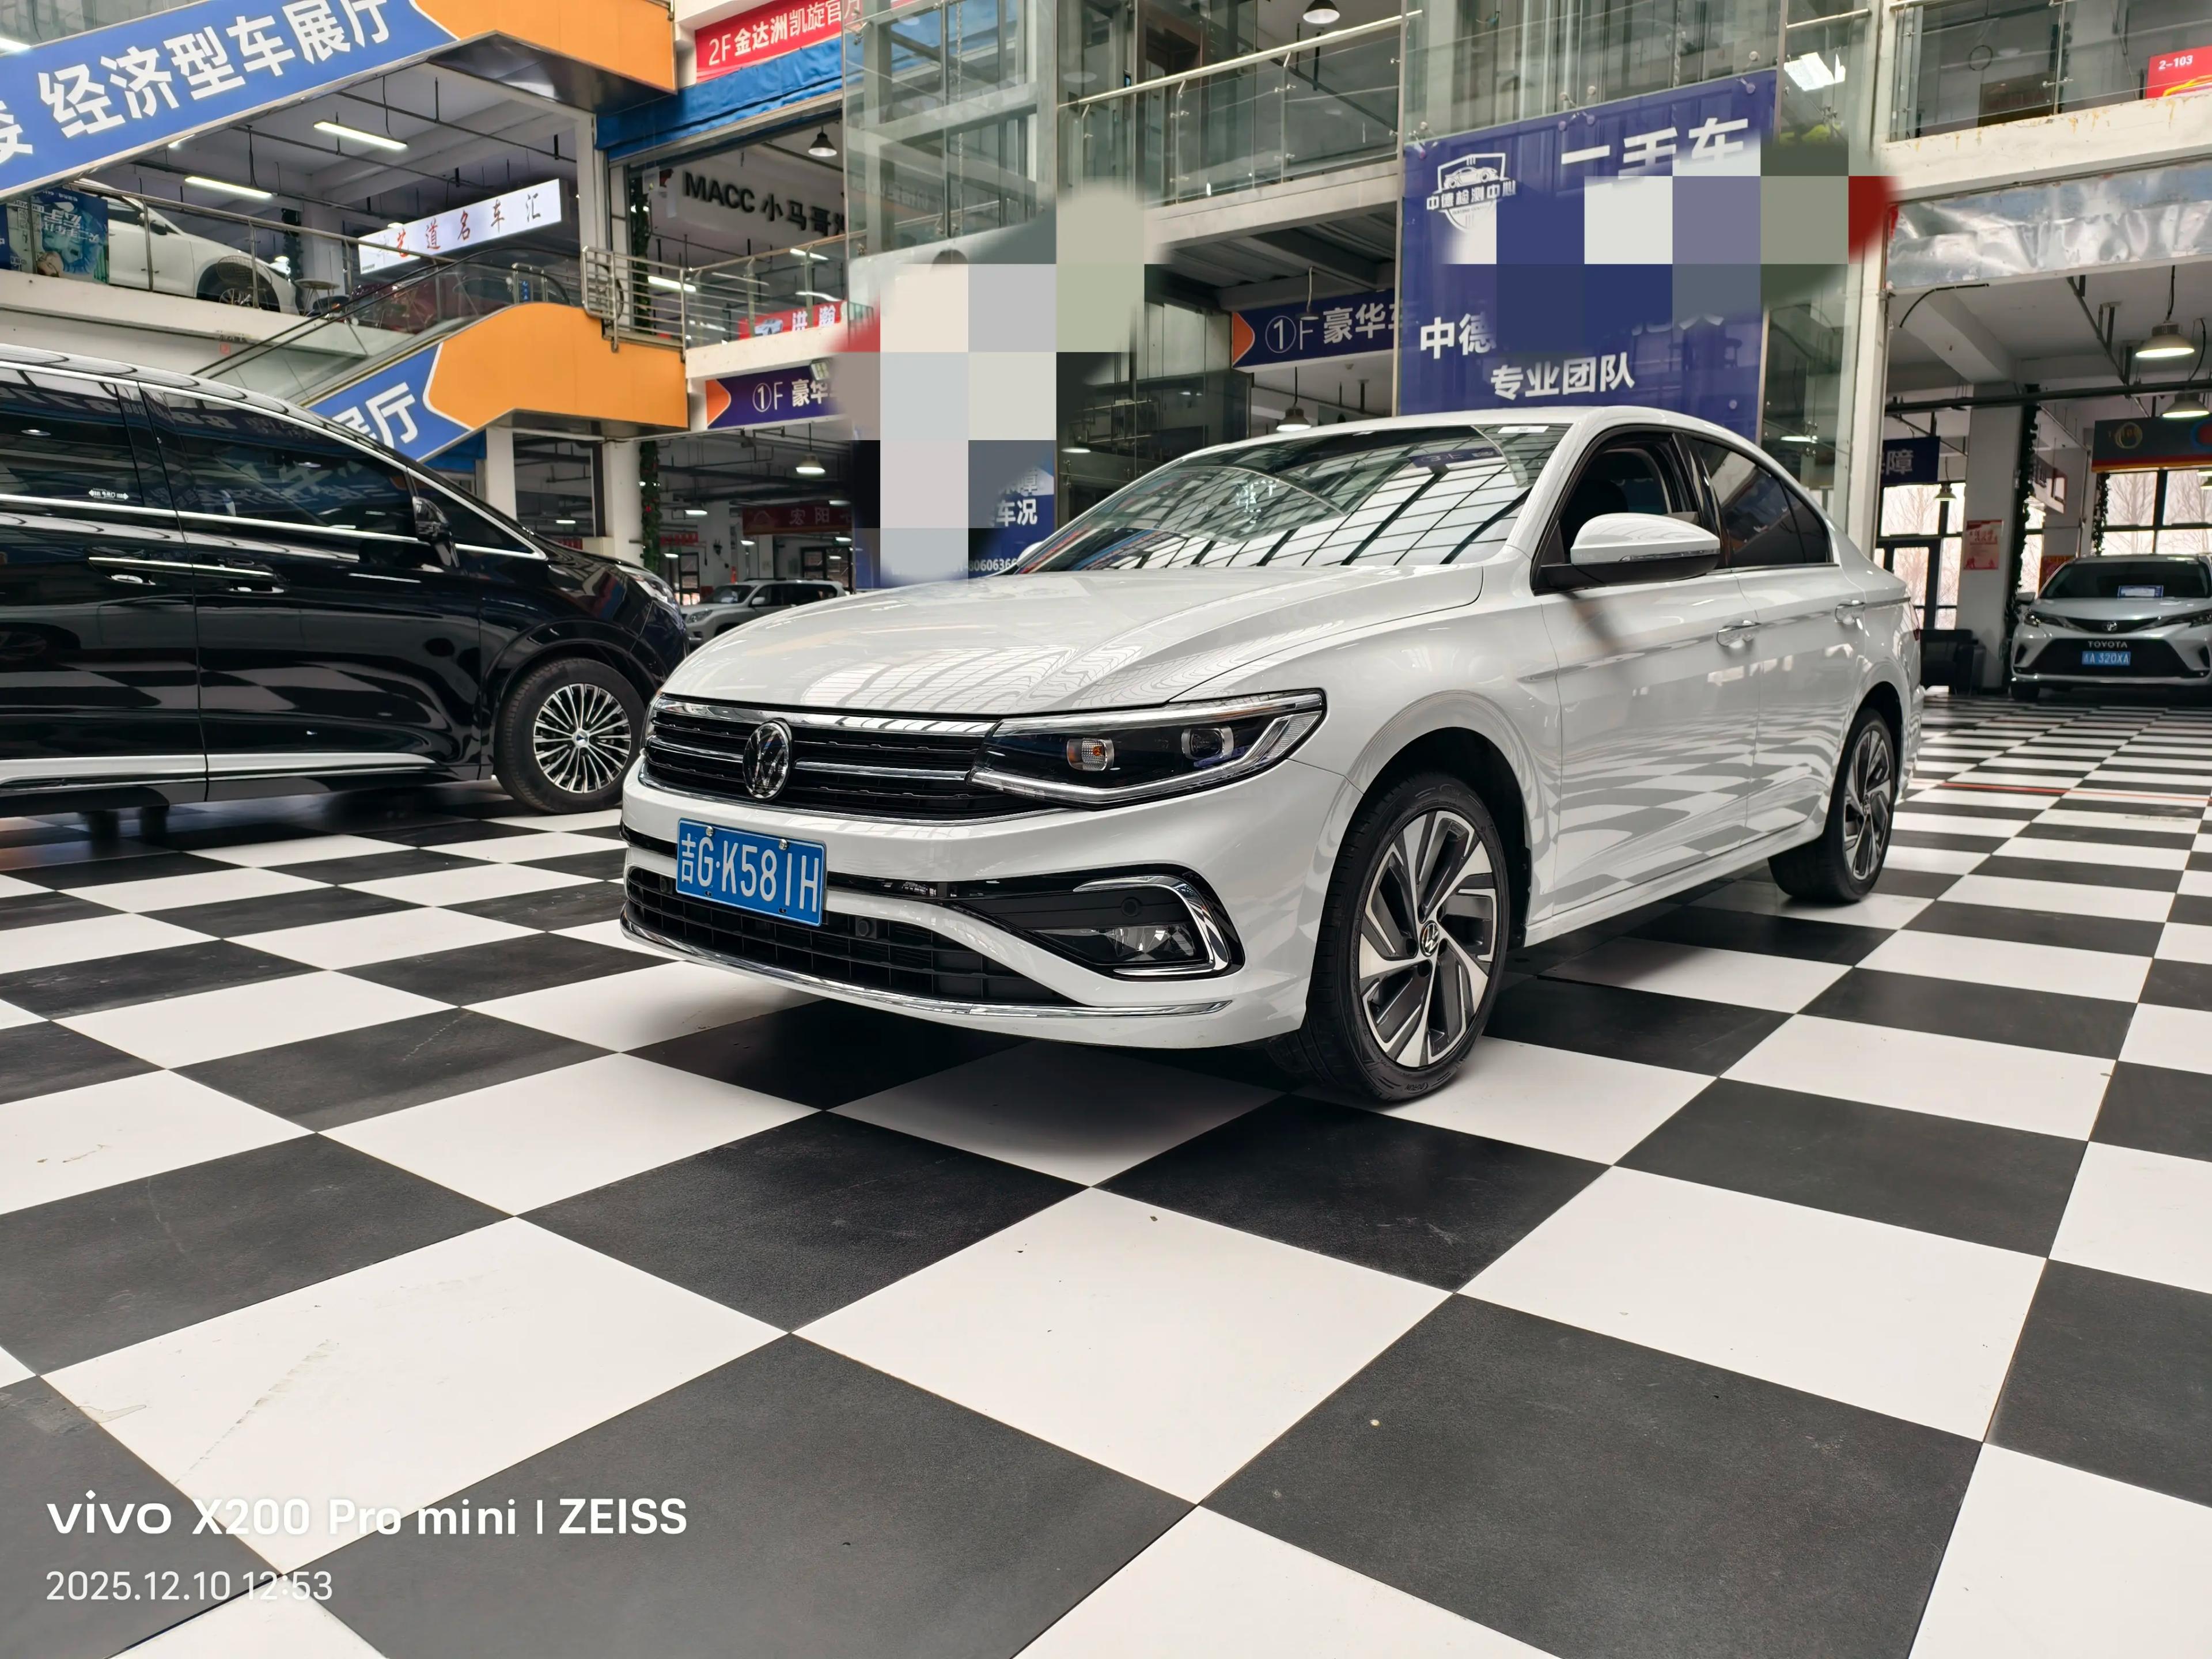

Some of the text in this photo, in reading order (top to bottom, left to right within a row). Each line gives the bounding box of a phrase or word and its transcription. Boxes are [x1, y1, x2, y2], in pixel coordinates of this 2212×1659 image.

[38, 0, 392, 138] 经济型车展厅
[2158, 55, 2193, 70] 2-103
[683, 172, 755, 213] MACC
[1323, 302, 1395, 344] 豪华
[1490, 352, 1635, 401] 专业团队
